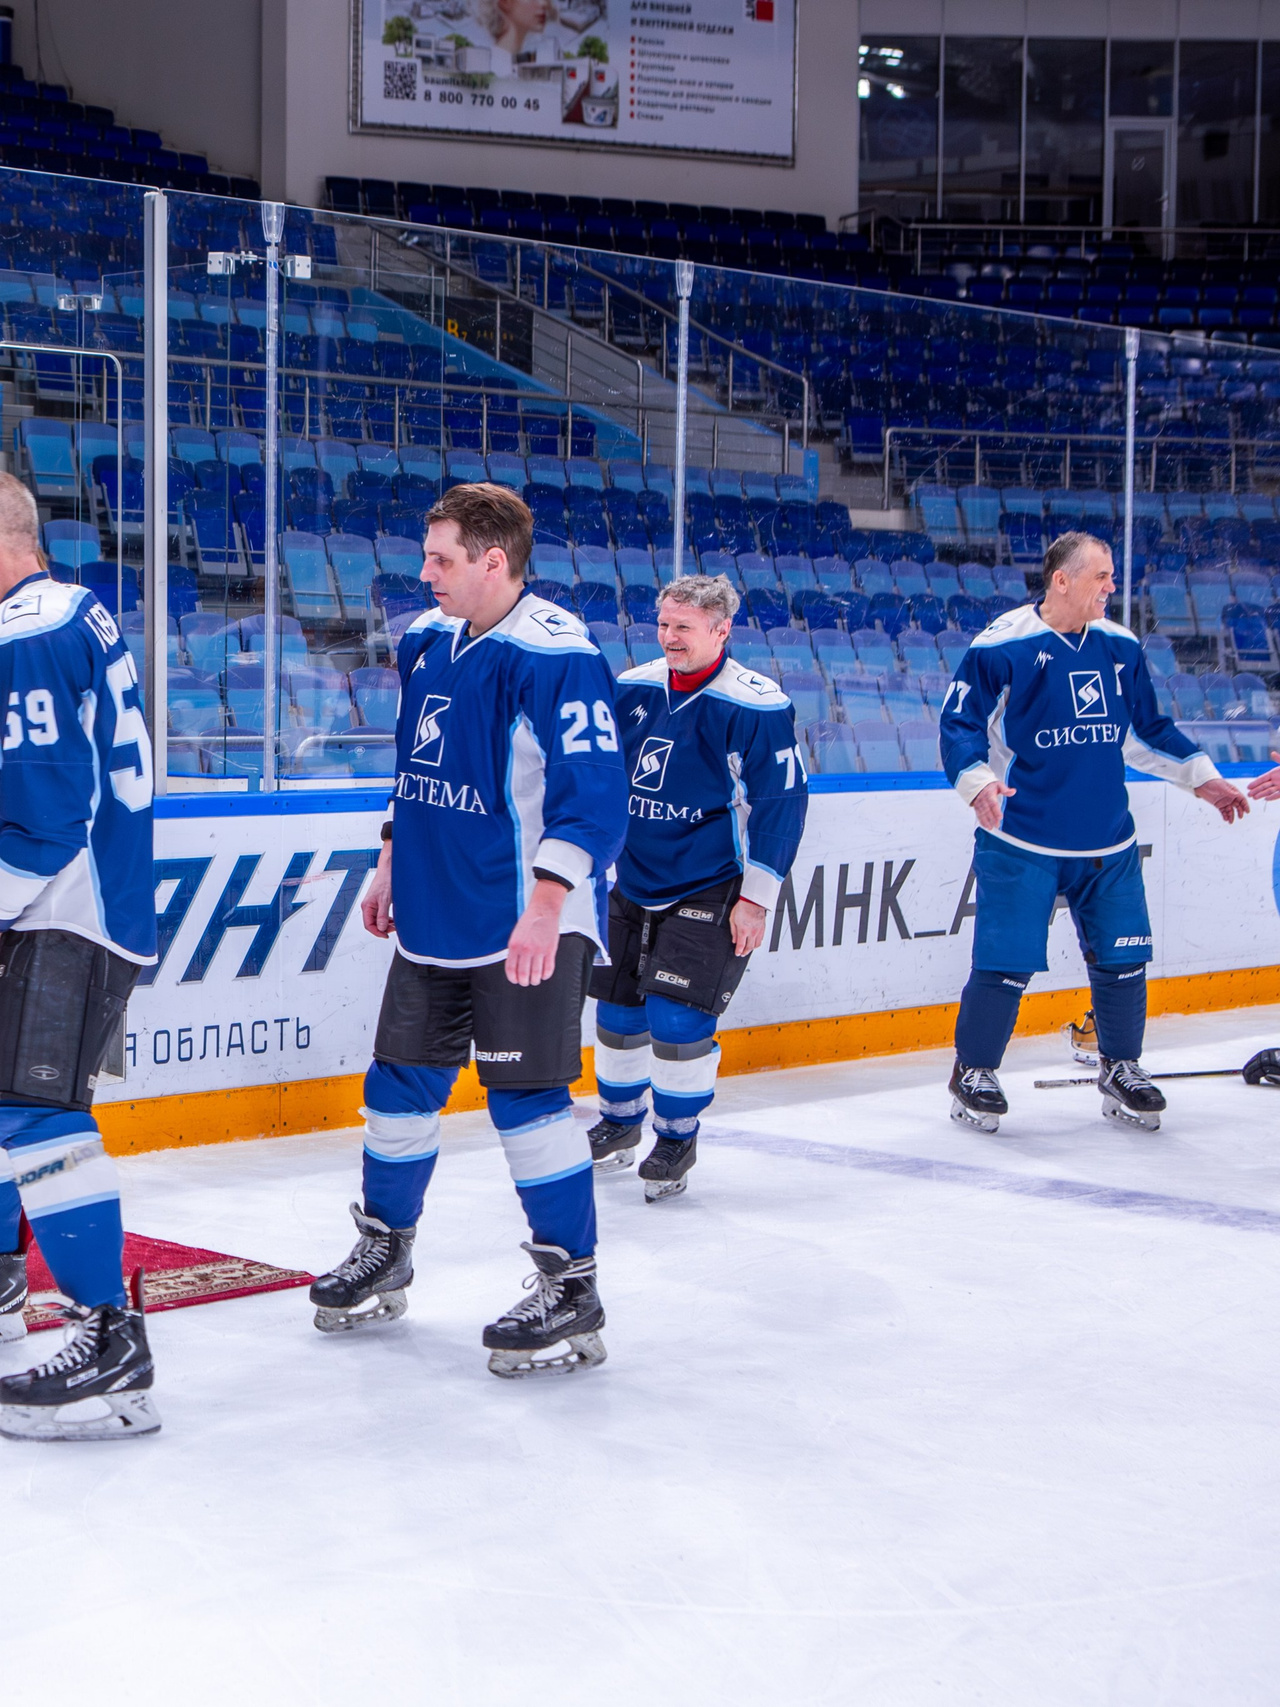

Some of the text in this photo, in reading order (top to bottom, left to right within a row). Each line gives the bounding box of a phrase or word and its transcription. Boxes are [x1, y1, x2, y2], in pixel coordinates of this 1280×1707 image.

[649, 2, 692, 14] ВНЕШНЕЙ
[639, 18, 694, 32] ВНУТРЕННЕЙ
[696, 22, 734, 35] ОТДЕЛКИ
[424, 90, 540, 111] 8 800 770 00 45
[559, 699, 620, 756] 29
[395, 772, 488, 816] ИСТЕМА
[627, 794, 704, 824] СТЕМА
[680, 908, 713, 921] CCM
[657, 972, 689, 987] CCM
[152, 1017, 311, 1067] ОБЛАСТЬ
